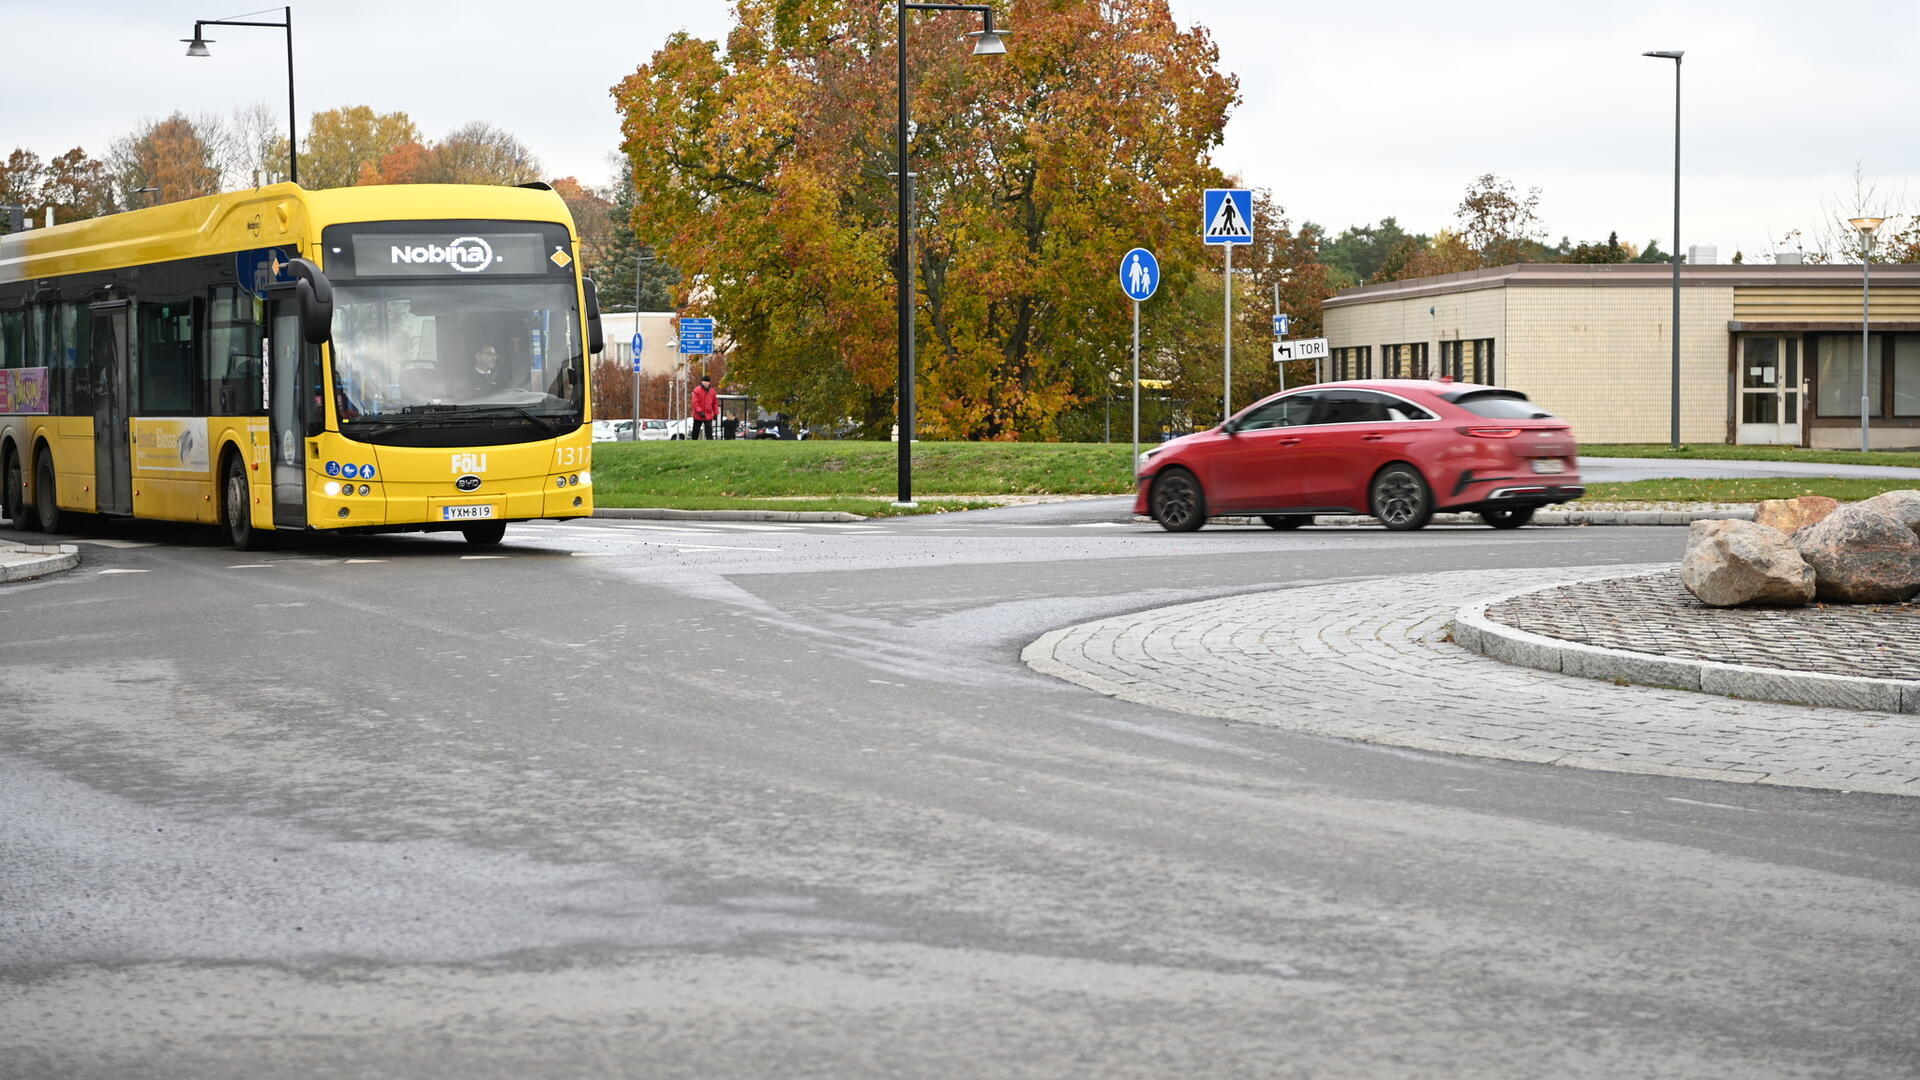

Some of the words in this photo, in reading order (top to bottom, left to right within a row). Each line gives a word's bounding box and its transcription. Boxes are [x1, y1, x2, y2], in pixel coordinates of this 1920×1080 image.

[1299, 342, 1325, 355] TORI
[556, 446, 592, 466] 1317
[450, 506, 490, 518] YXM-819
